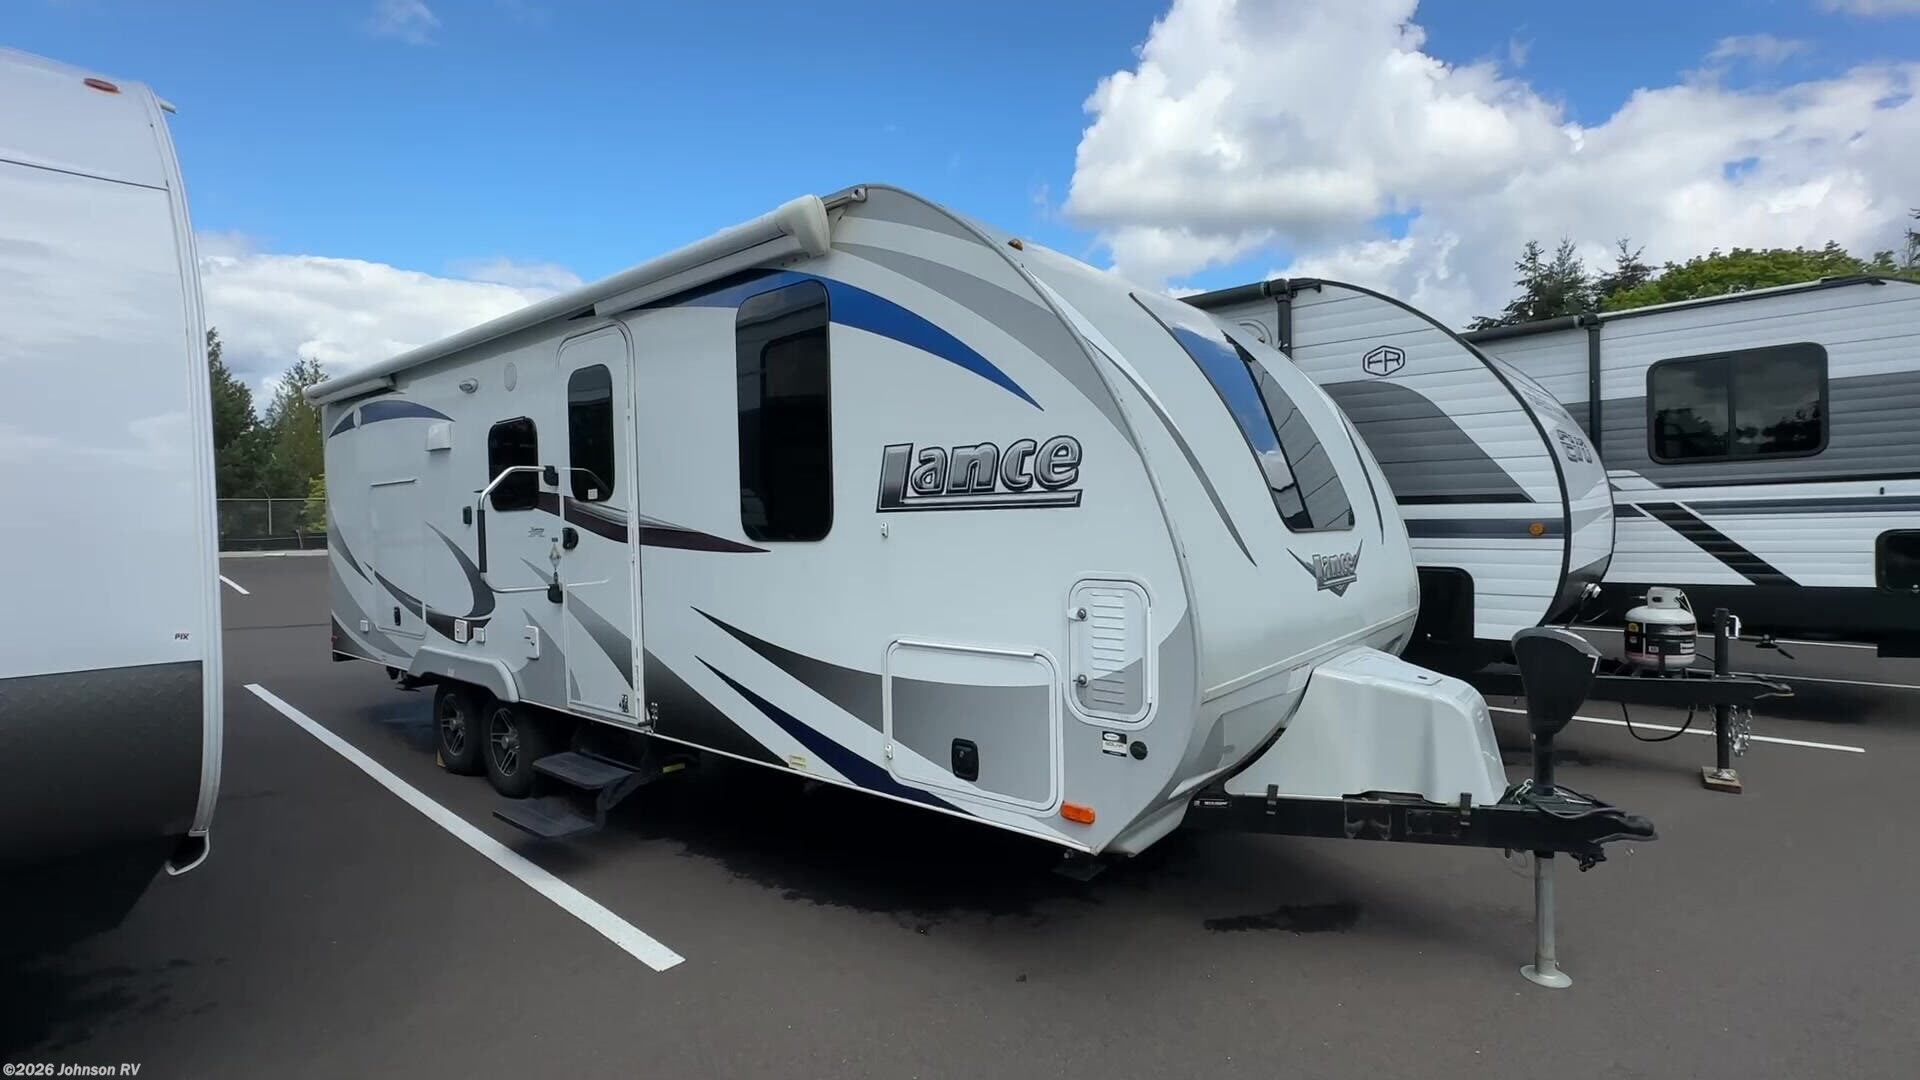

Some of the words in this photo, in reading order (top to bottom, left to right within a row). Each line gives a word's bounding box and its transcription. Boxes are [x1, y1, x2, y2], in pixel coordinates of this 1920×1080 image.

[1367, 349, 1401, 372] FR
[876, 434, 1083, 513] Lance
[1312, 552, 1357, 591] Lance
